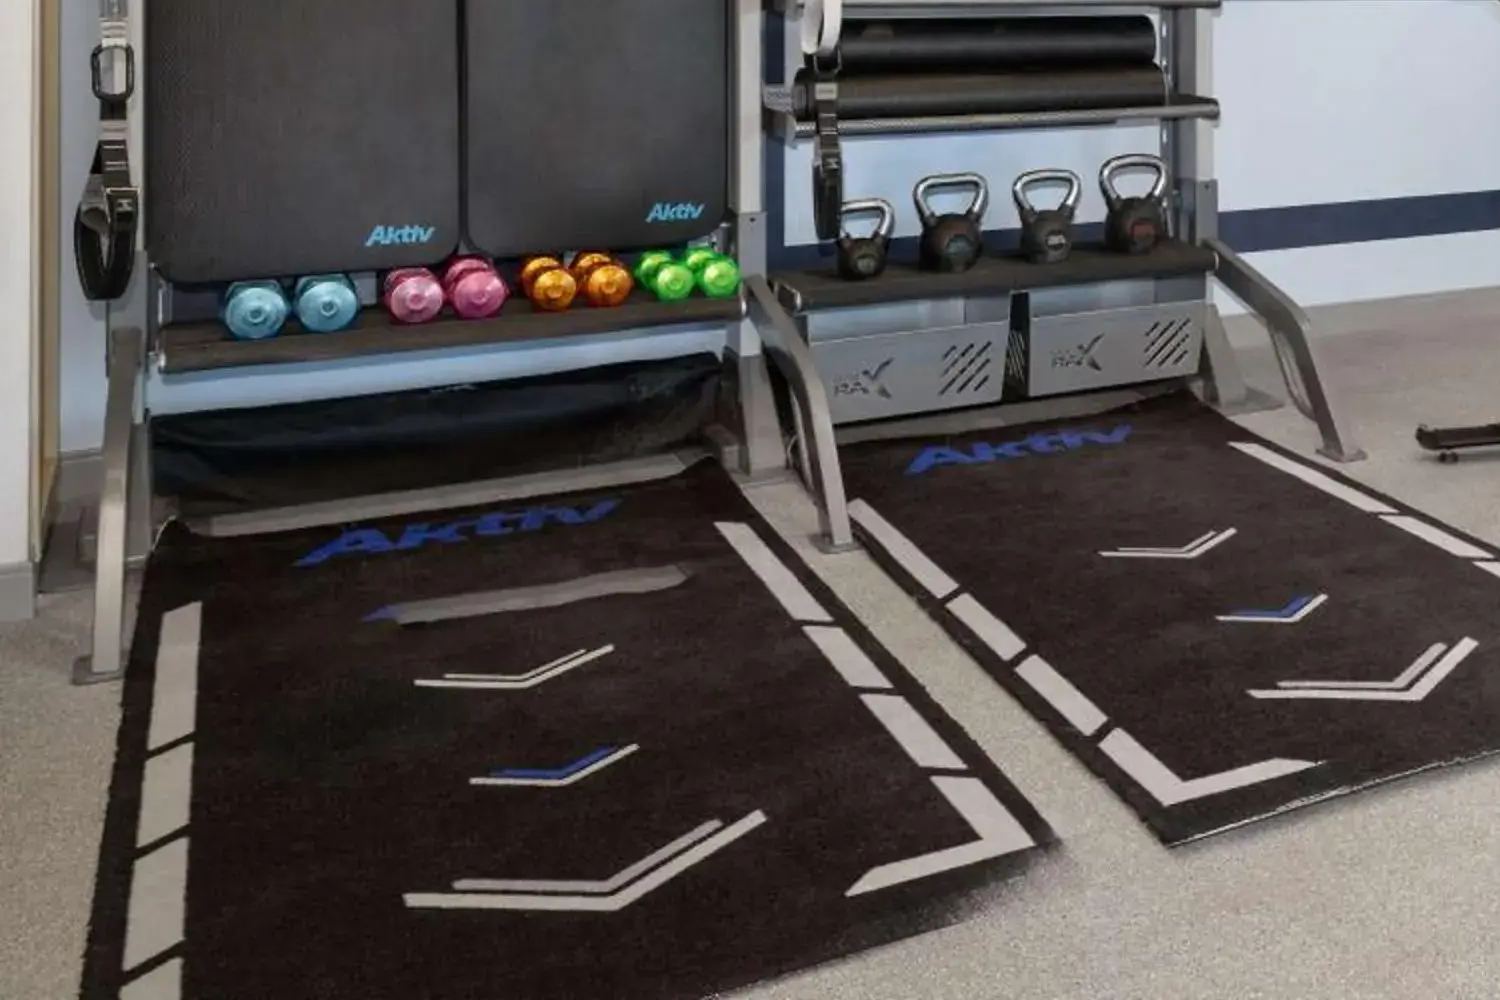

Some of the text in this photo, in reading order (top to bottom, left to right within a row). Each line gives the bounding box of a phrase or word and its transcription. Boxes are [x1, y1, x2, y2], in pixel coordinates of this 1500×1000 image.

[645, 202, 706, 223] Aktiv
[366, 224, 436, 247] Aktiv
[903, 423, 1133, 476] Aktiv
[293, 498, 622, 567] Aktiv
